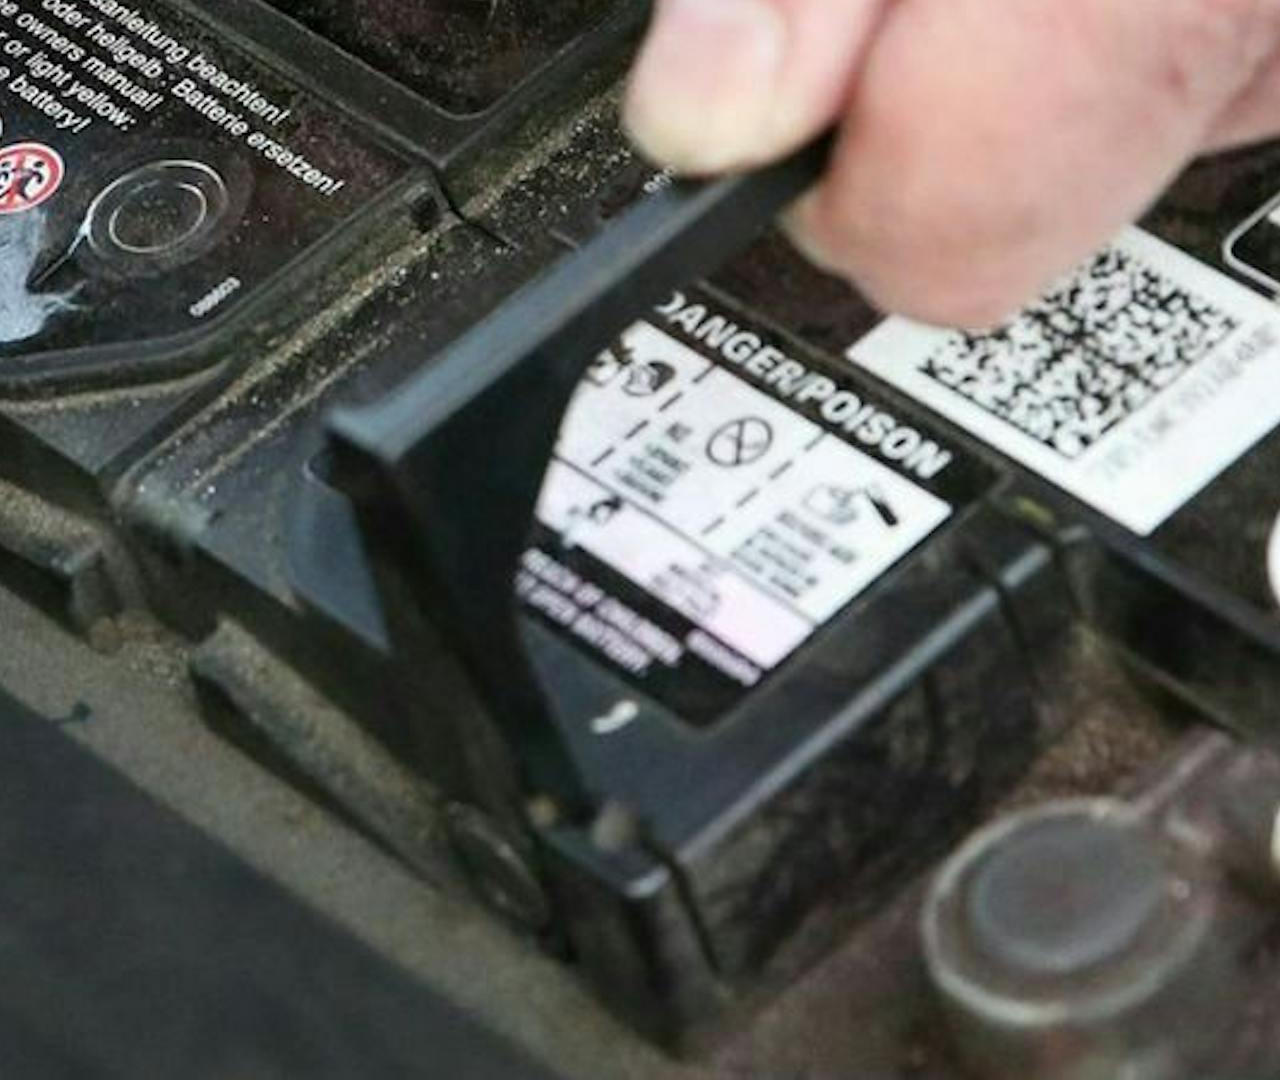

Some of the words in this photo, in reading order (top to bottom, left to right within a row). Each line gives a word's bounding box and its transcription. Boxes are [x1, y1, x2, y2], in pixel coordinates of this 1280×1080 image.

[3, 38, 32, 59] or
[24, 50, 73, 88] light
[61, 79, 137, 132] yellow:
[8, 72, 92, 134] battery!
[15, 12, 86, 62] owners
[81, 55, 165, 112] manual!
[85, 21, 165, 80] hellgelb
[172, 77, 249, 136] Batterie
[246, 130, 345, 196] ersetzen!
[186, 52, 292, 126] beachten!
